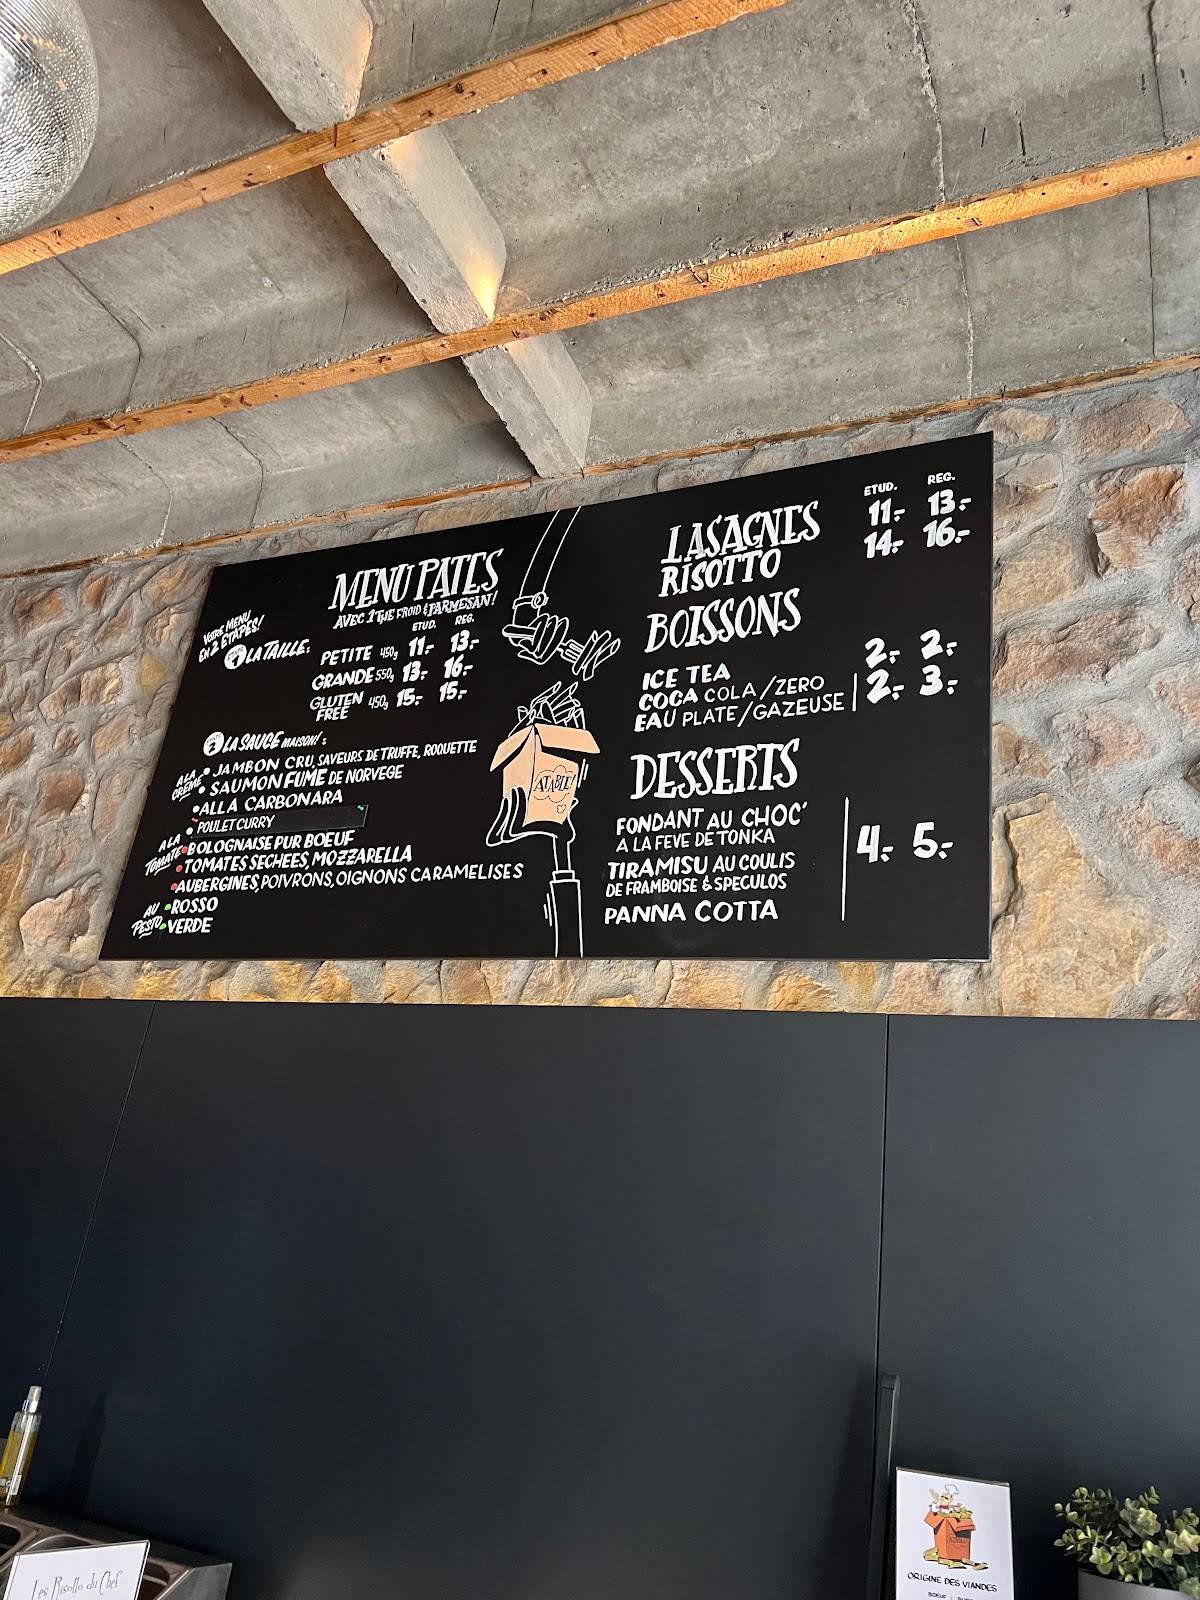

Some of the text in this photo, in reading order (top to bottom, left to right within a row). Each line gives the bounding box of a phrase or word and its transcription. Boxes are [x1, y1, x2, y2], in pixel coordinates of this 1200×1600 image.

[864, 472, 956, 496] ETUD. REG.
[661, 501, 820, 564] LASAGNES
[328, 548, 504, 612] MENU PATES
[658, 549, 781, 598] RISOTTO
[203, 610, 251, 645] VOTRE MENU
[333, 612, 364, 629] AVEC
[396, 605, 421, 619] FROID
[412, 614, 475, 631] ETUD. REG.
[644, 588, 801, 653] BOISSONS
[199, 647, 210, 662] EN
[210, 641, 219, 656] 2
[221, 614, 265, 649] ETAPES!
[245, 647, 262, 664] LA
[320, 645, 373, 665] PETITE
[380, 646, 398, 660] 450g
[312, 666, 375, 690] GRANDE
[375, 668, 394, 683] 550g
[642, 668, 679, 690] ICE
[686, 663, 731, 684] TEA
[310, 691, 364, 710] GLUTEN
[368, 695, 388, 710] 450g
[639, 688, 698, 711] COCA
[316, 706, 349, 721] FREE
[634, 709, 676, 732] EAU
[222, 736, 238, 753] LA
[238, 731, 284, 751] SAUCE
[212, 758, 280, 777] JAMBON
[317, 750, 364, 766] SAVEURS
[365, 749, 380, 761] DE
[424, 740, 477, 757] ROQUETTE
[630, 738, 800, 799] DESSERTS
[172, 774, 204, 801] CREME
[210, 764, 404, 796] SAUMON FUME DE NORVEGE
[245, 789, 343, 812] CARBONARA
[197, 815, 275, 834] POULET CURRY
[616, 808, 704, 835] FONDANT
[707, 810, 733, 830] AU
[187, 830, 355, 856] BOLOGNAISE PUR BOEUF
[616, 828, 775, 852] A LA FEVE DE TONKA
[145, 845, 183, 876] TOMATE
[184, 854, 250, 874] TOMATES
[312, 845, 412, 866] MOZZARELLA
[608, 852, 796, 880] TIRAMISU AU COULIS
[336, 867, 407, 886] OIGNONS
[411, 863, 524, 882] CARAMELISES
[606, 883, 623, 898] DE
[626, 878, 698, 895] FRAMBOISE
[714, 873, 788, 891] SPECULOS
[143, 902, 160, 918] AU
[171, 897, 218, 914] ROSSO
[604, 899, 778, 925] PANNA COTTA
[131, 916, 163, 936] PESTO
[168, 917, 213, 934] VERDE
[87, 1573, 98, 1589] du
[908, 1572, 997, 1592] ORIGINE DES VIANDES
